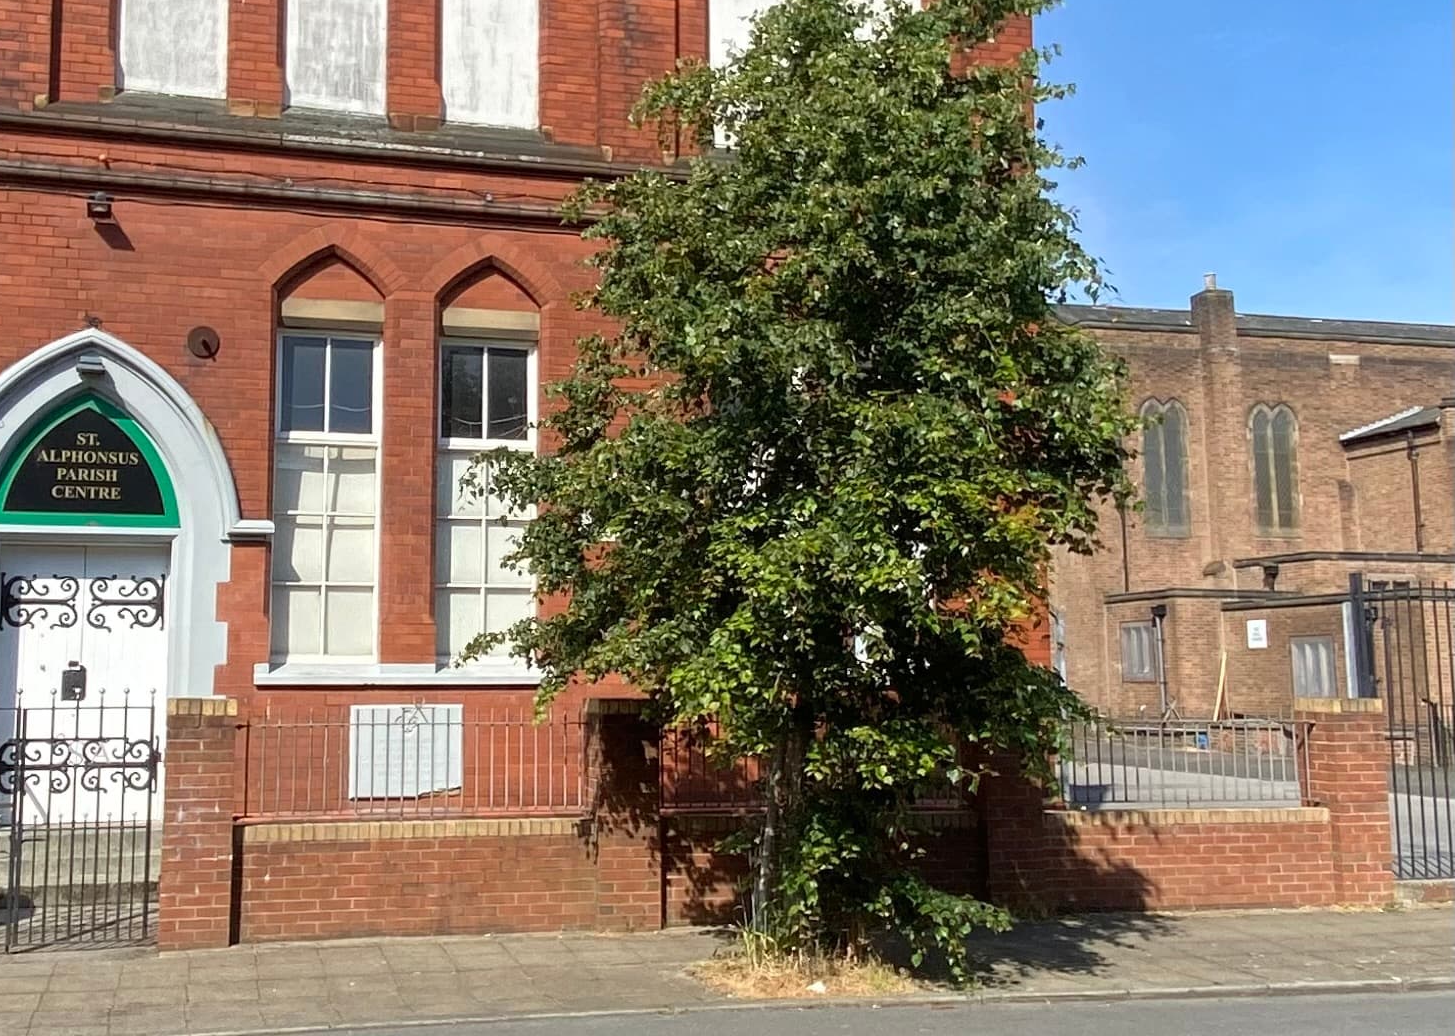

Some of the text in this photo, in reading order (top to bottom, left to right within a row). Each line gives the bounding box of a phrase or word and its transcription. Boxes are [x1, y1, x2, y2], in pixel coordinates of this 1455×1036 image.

[76, 432, 100, 446] ST.
[37, 449, 139, 465] ALPHONSUS
[56, 467, 117, 482] PARISH
[51, 485, 121, 499] CENTRE
